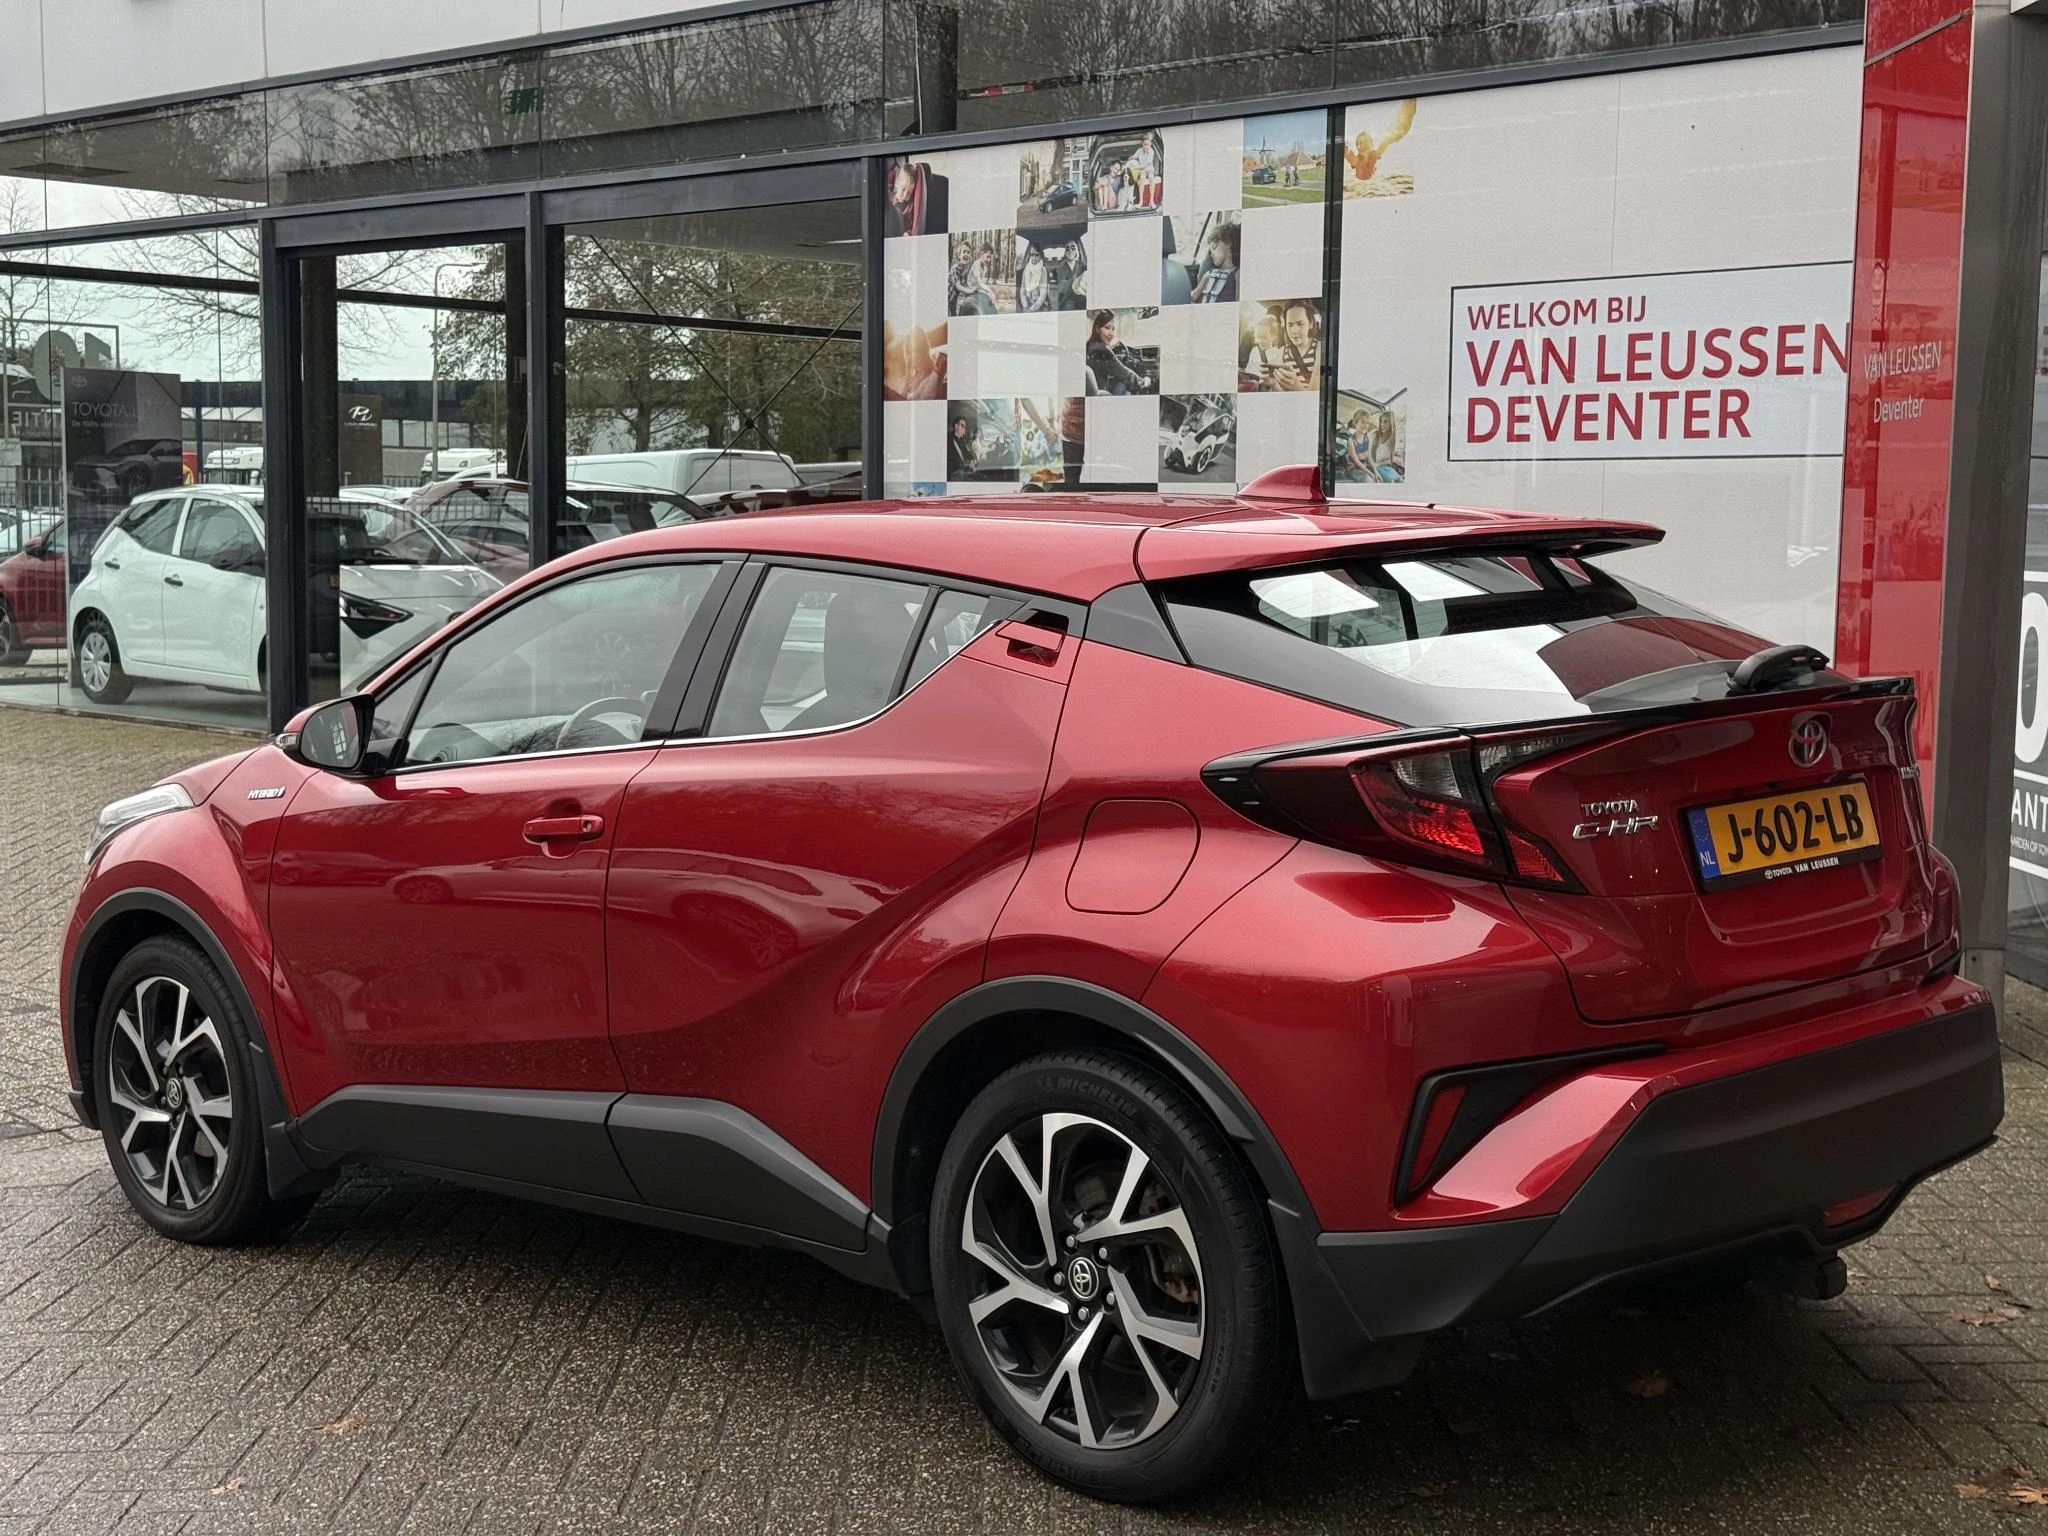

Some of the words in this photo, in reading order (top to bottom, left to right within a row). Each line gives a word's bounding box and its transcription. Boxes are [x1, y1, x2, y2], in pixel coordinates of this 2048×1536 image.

[1467, 298, 1597, 331] WELKOM
[1606, 295, 1647, 324] BIJ
[1466, 336, 1577, 387] VAN
[1596, 322, 1850, 383] LEUSSEN
[1863, 351, 1888, 380] VAN
[1889, 340, 1942, 376] LEUSSEN
[71, 401, 129, 418] TOYOTA
[1466, 388, 1752, 444] DEVENTER
[1873, 394, 1925, 424] Deventer
[1581, 799, 1639, 817] TOYOTA
[1572, 815, 1660, 840] C-HR
[1727, 794, 1864, 864] J-602-LB
[1699, 851, 1716, 867] NL
[1772, 866, 1793, 878] TOYOTA
[1794, 862, 1809, 873] VAN
[1810, 856, 1840, 870] LEUSSEN
[1056, 1077, 1137, 1117] MICHELIN
